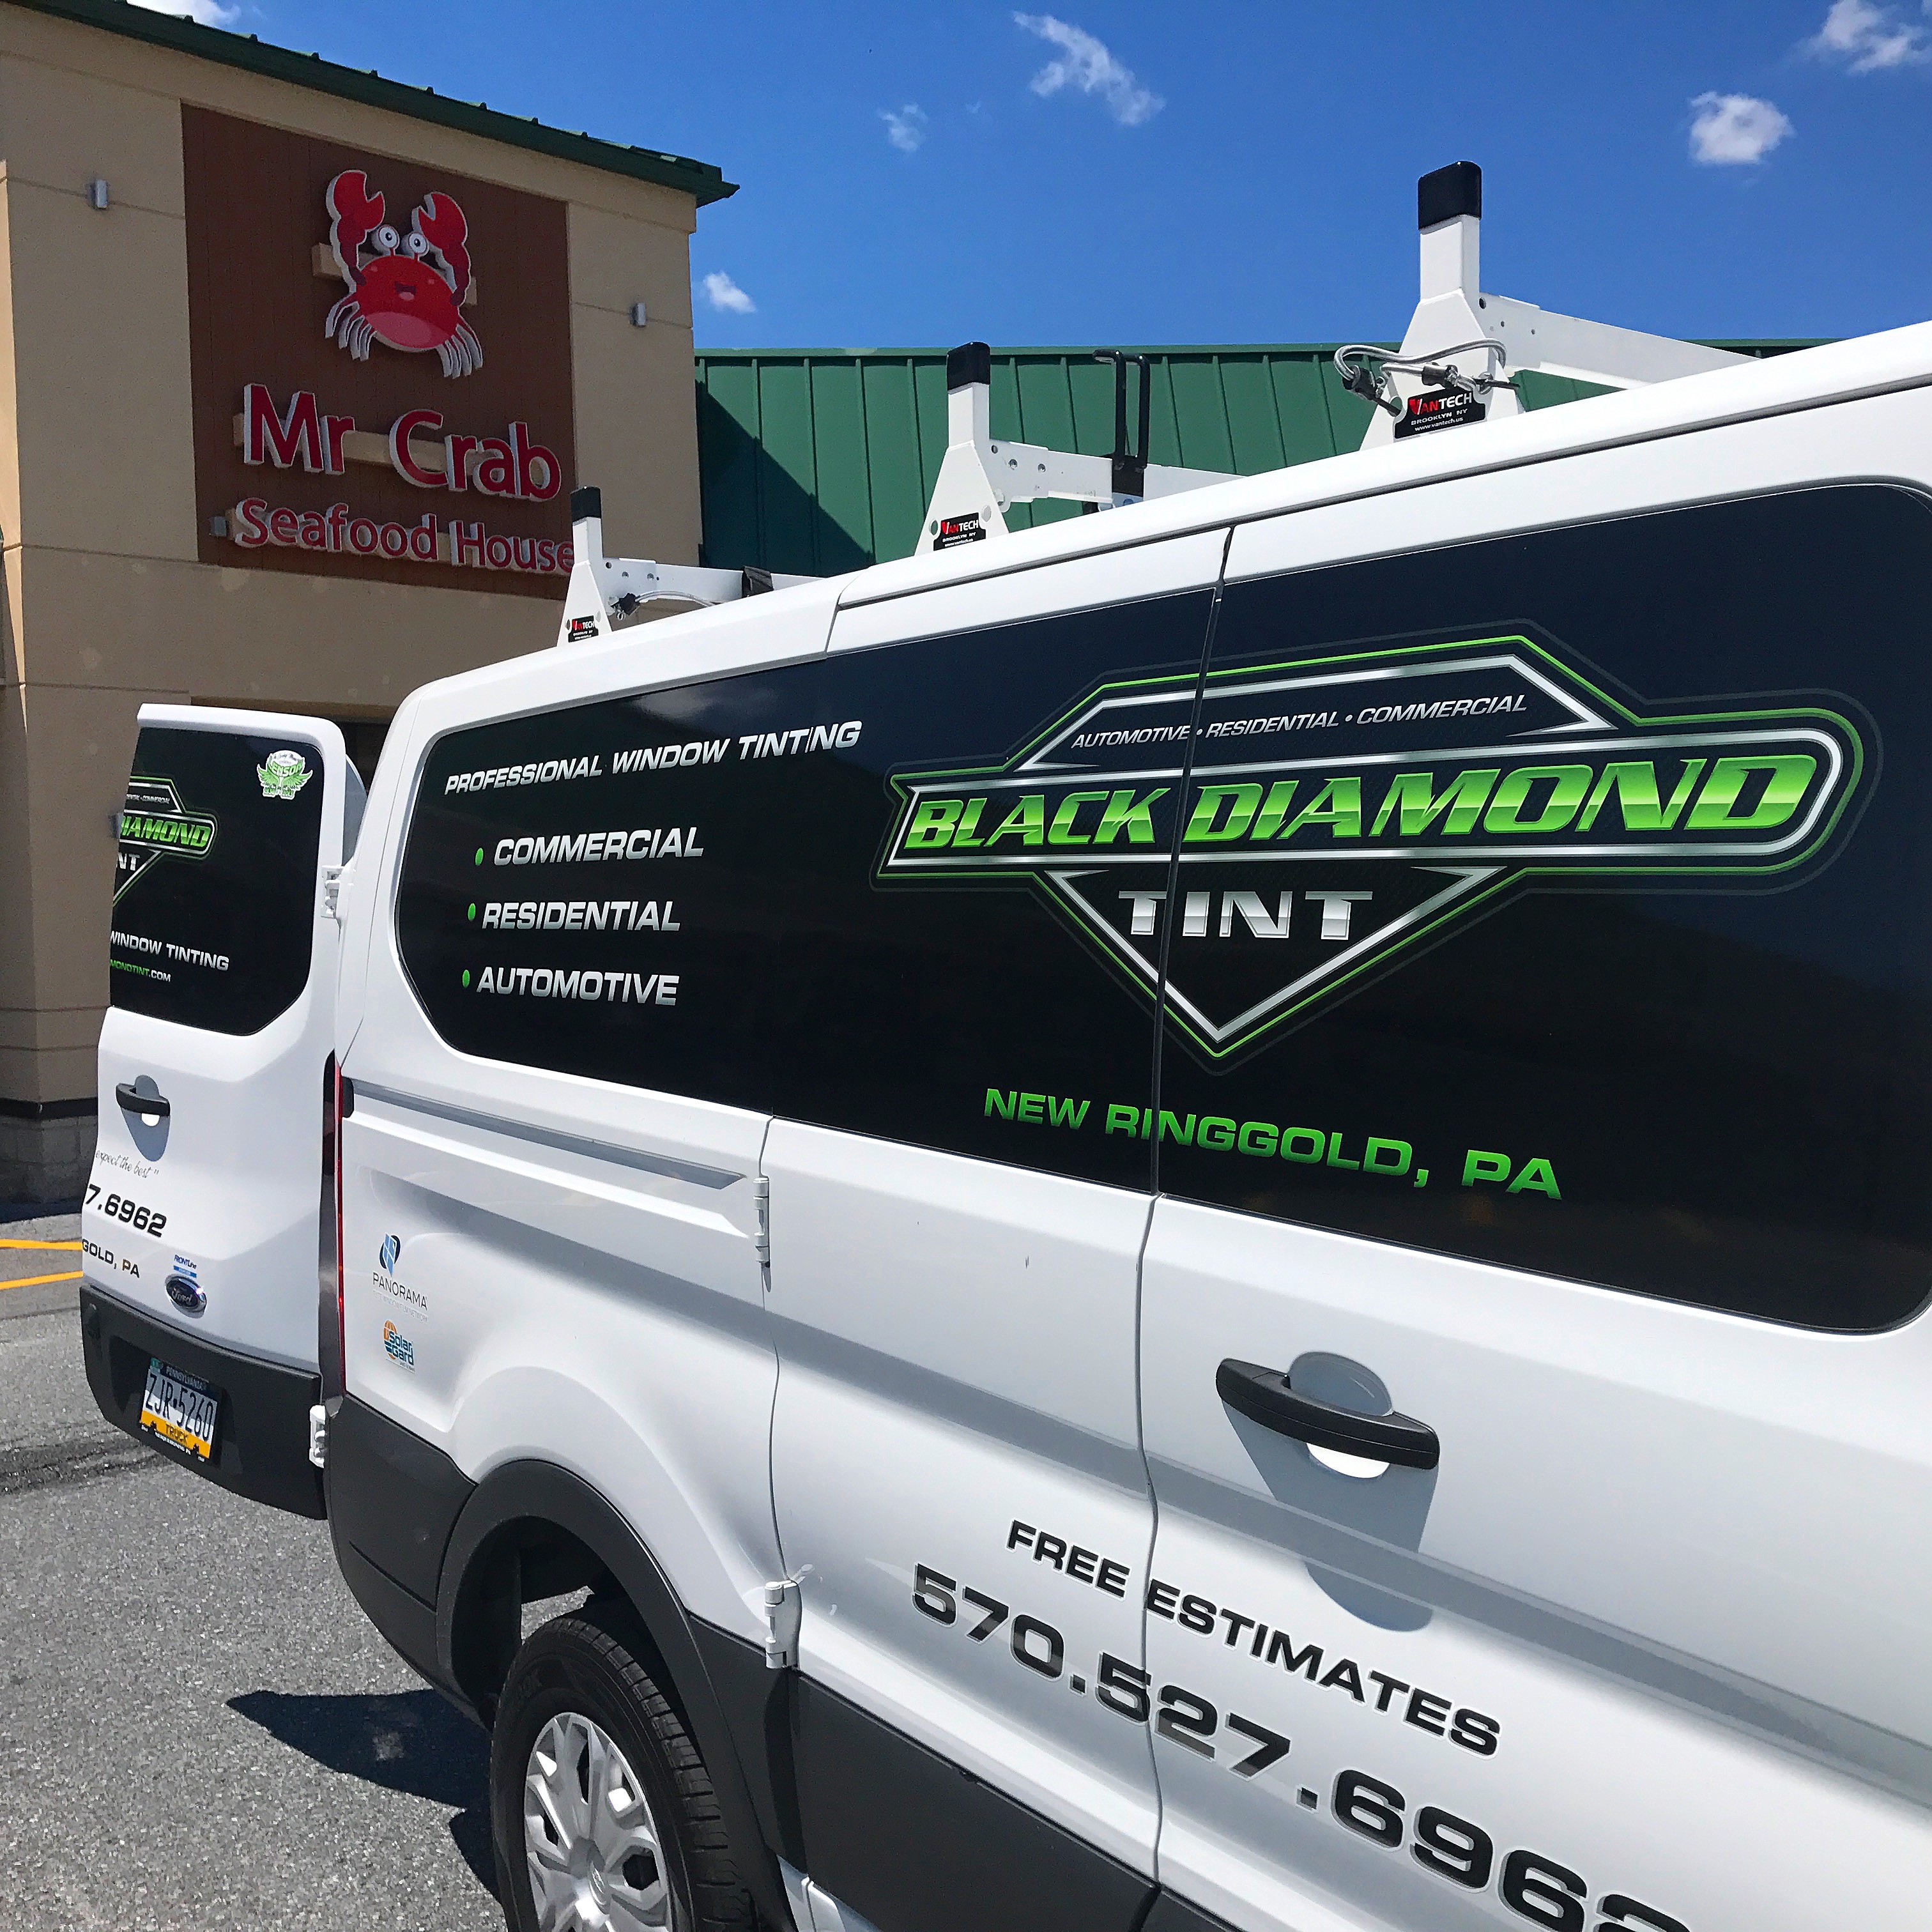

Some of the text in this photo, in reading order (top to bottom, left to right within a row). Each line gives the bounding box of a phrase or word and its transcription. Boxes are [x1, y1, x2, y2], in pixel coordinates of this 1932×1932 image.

[244, 384, 562, 502] Mr Crab
[1411, 412, 1452, 425] BROOKLYN
[235, 497, 574, 574] Seafood House
[1071, 694, 1528, 749] AUTOMOTIVE RESIDENTIAL COMMERCIAL
[444, 720, 863, 795] PROFESSIONAL WINDOW TINTING
[903, 755, 1818, 850] BLACK DIAMOND
[494, 826, 704, 866] COMMERCIAL
[482, 901, 680, 931] RESIDENTIAL
[1118, 891, 1373, 940] TINT
[110, 930, 229, 971] WINDOW TINTING
[476, 967, 680, 1006] AUTOMOTIVE
[119, 1156, 133, 1172] the
[983, 1088, 1563, 1201] NEW RINGGOLD, PA
[85, 1183, 167, 1238] 7.6962
[82, 1238, 140, 1279] GOLD, PA
[373, 1272, 427, 1311] PANORAMA
[1005, 1518, 1503, 1759] FREE ESTIMATES
